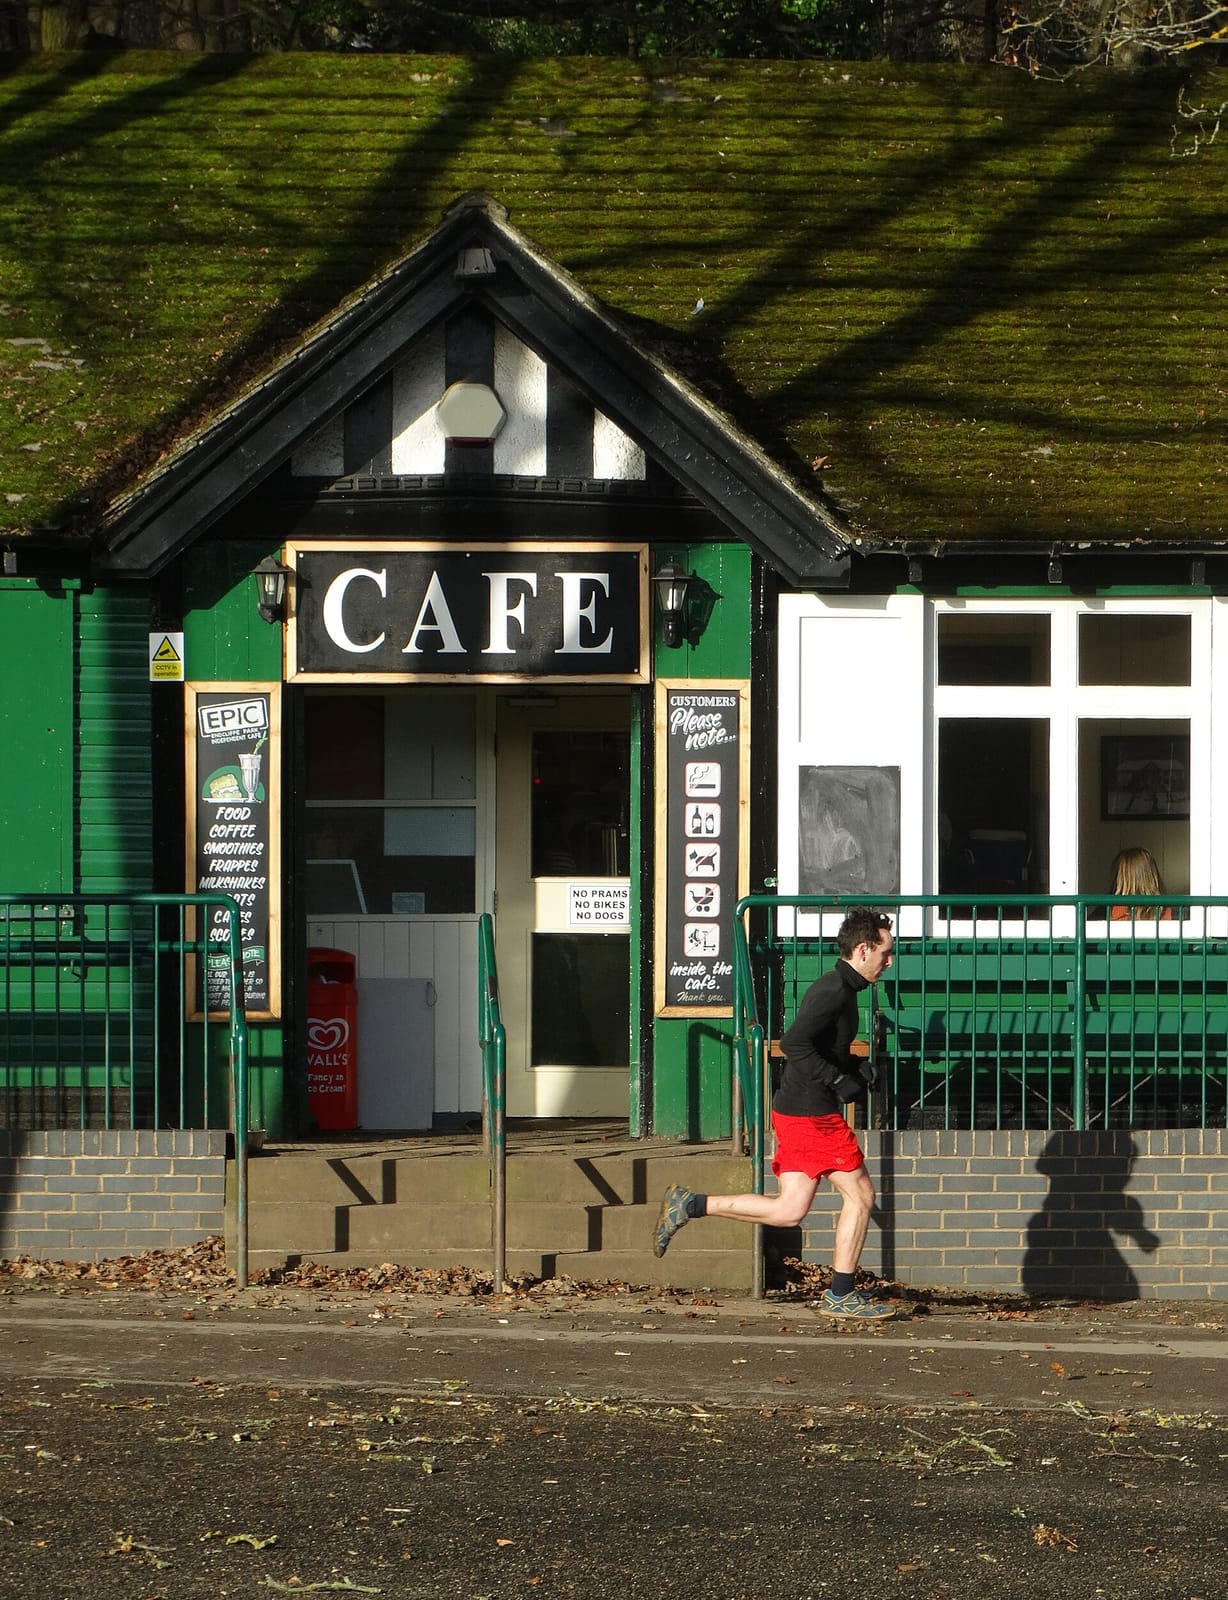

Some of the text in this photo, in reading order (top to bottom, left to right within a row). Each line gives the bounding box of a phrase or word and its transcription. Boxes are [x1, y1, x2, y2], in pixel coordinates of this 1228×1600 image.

[322, 567, 614, 654] CAFE
[670, 695, 737, 707] CUSTOMERS
[206, 705, 260, 730] EPIC
[670, 707, 723, 735] Please
[242, 727, 260, 735] PARK
[211, 734, 246, 744] INDEPENDENT
[215, 806, 251, 821] FOOD
[209, 824, 257, 838] COFFEE
[203, 842, 264, 855] SMOOTHIES
[209, 859, 258, 873] FRAPPES
[199, 876, 266, 890] MILKSHAKES
[573, 890, 628, 898] NO PRAMS
[575, 901, 626, 909] NO BIKES
[214, 910, 253, 924] CAES
[576, 912, 624, 920] NO DOGS
[209, 927, 255, 942] SCOES
[670, 961, 733, 976] inside the
[676, 991, 705, 1002] Thank
[308, 1073, 333, 1084] Fancy
[307, 1085, 317, 1093] ce
